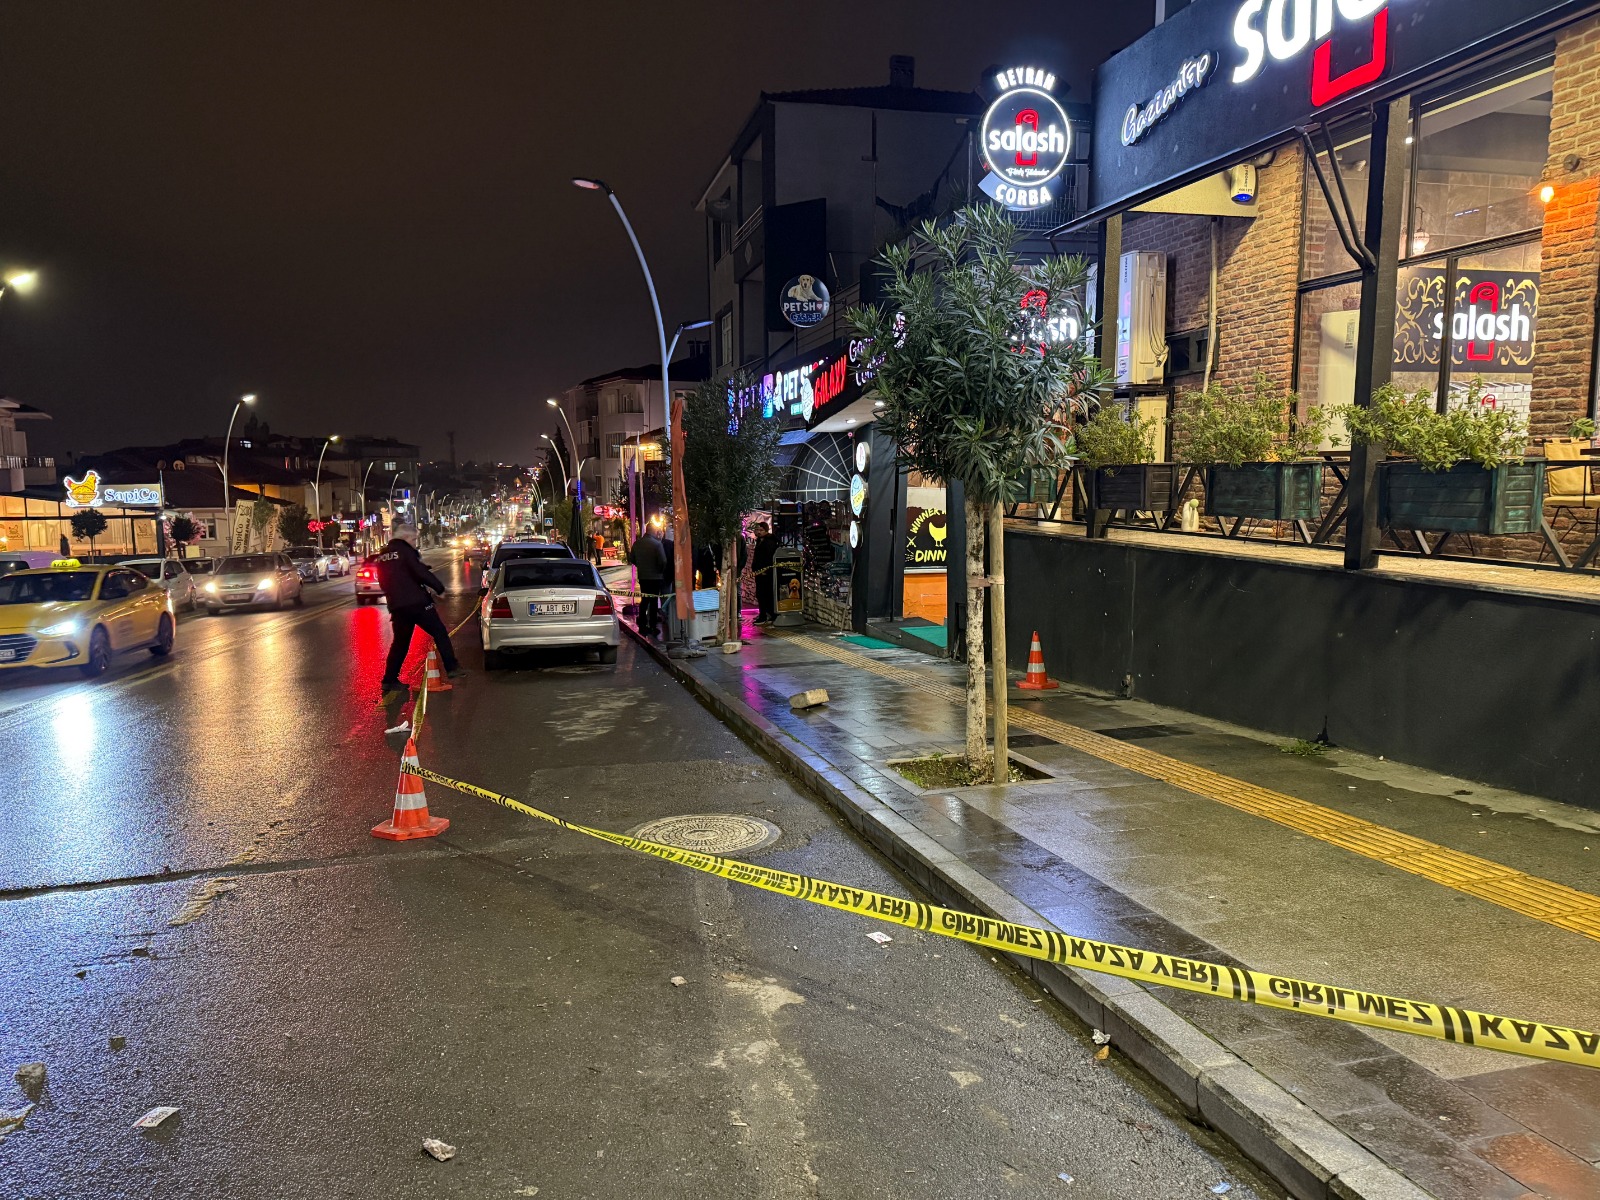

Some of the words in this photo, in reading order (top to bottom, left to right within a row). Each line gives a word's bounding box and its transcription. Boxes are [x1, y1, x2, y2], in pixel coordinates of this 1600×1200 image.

[996, 66, 1056, 90] BEYRAN
[1122, 53, 1209, 145] Gaziantep
[989, 125, 1064, 153] salash
[784, 302, 801, 312] PET
[1433, 304, 1530, 342] salash
[783, 369, 799, 402] PET
[814, 354, 847, 409] GALAXY
[105, 488, 158, 503] SapiCo
[234, 523, 244, 551] SapiCo
[561, 603, 574, 612] 697
